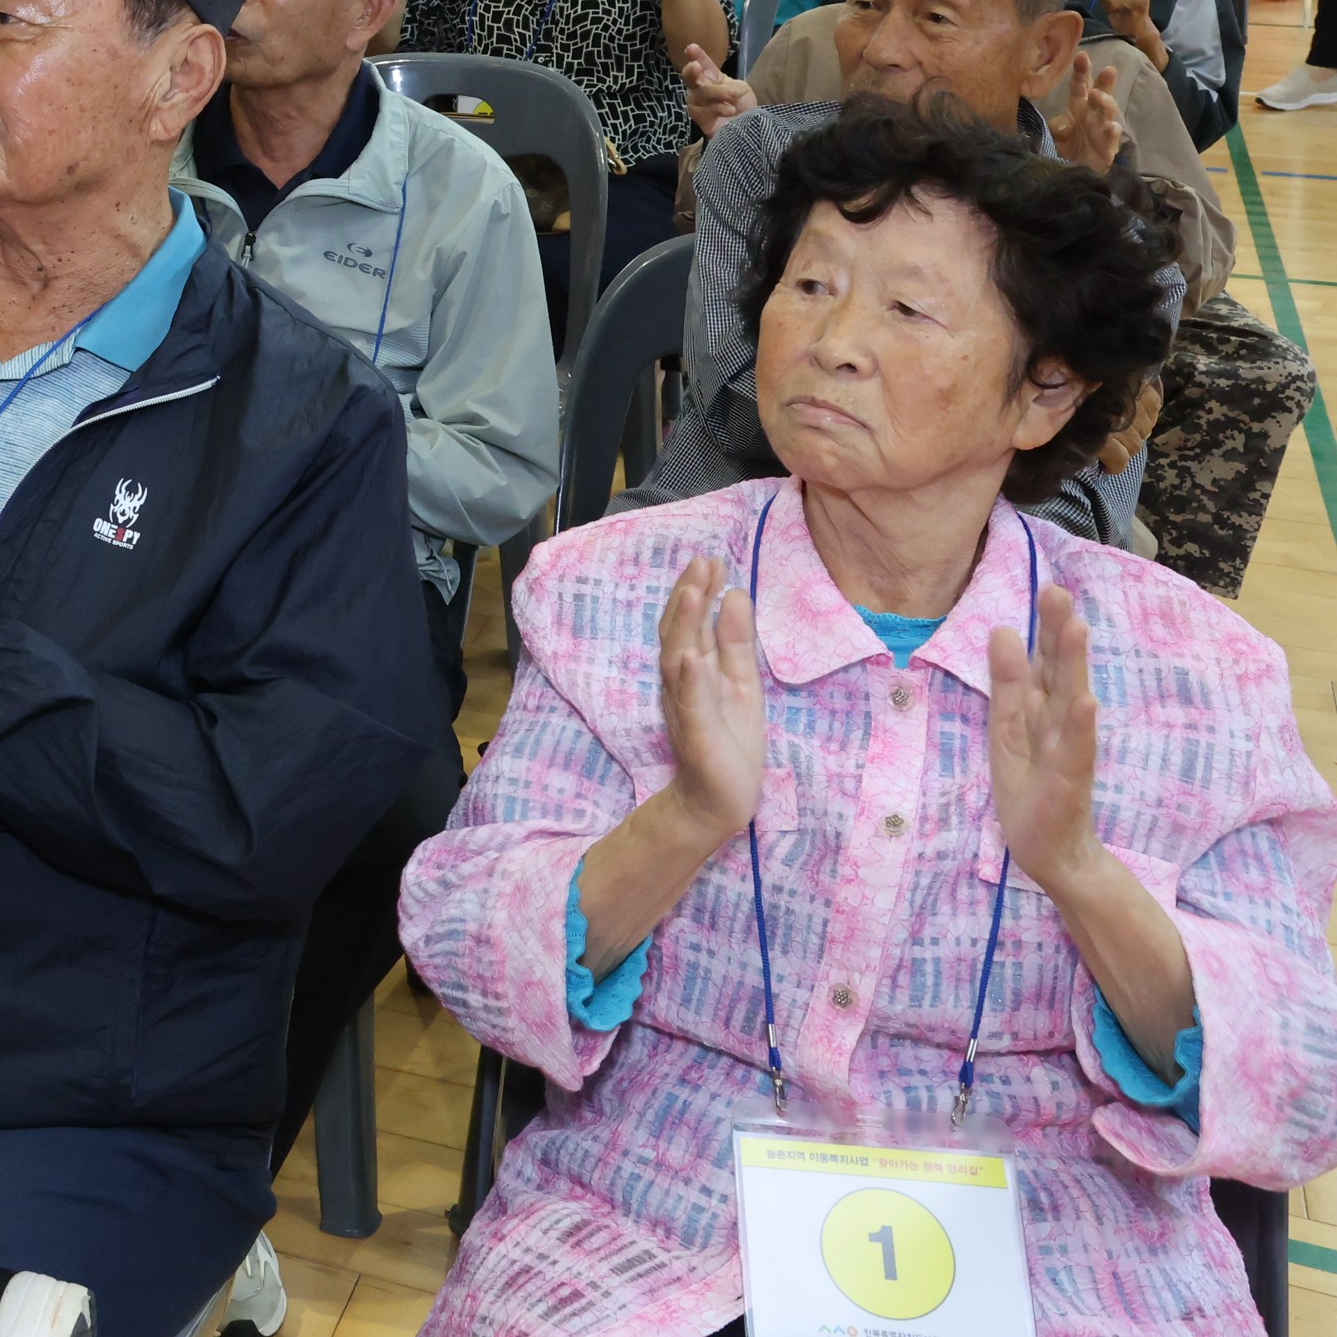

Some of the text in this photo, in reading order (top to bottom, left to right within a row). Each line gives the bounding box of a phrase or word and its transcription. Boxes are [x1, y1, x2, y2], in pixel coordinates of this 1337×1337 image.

[323, 250, 387, 280] EIDER
[92, 517, 141, 545] ONESPY
[93, 533, 134, 550] ACTIVE SPORTS
[766, 1148, 806, 1162] 농촌지역
[868, 1224, 898, 1281] 1
